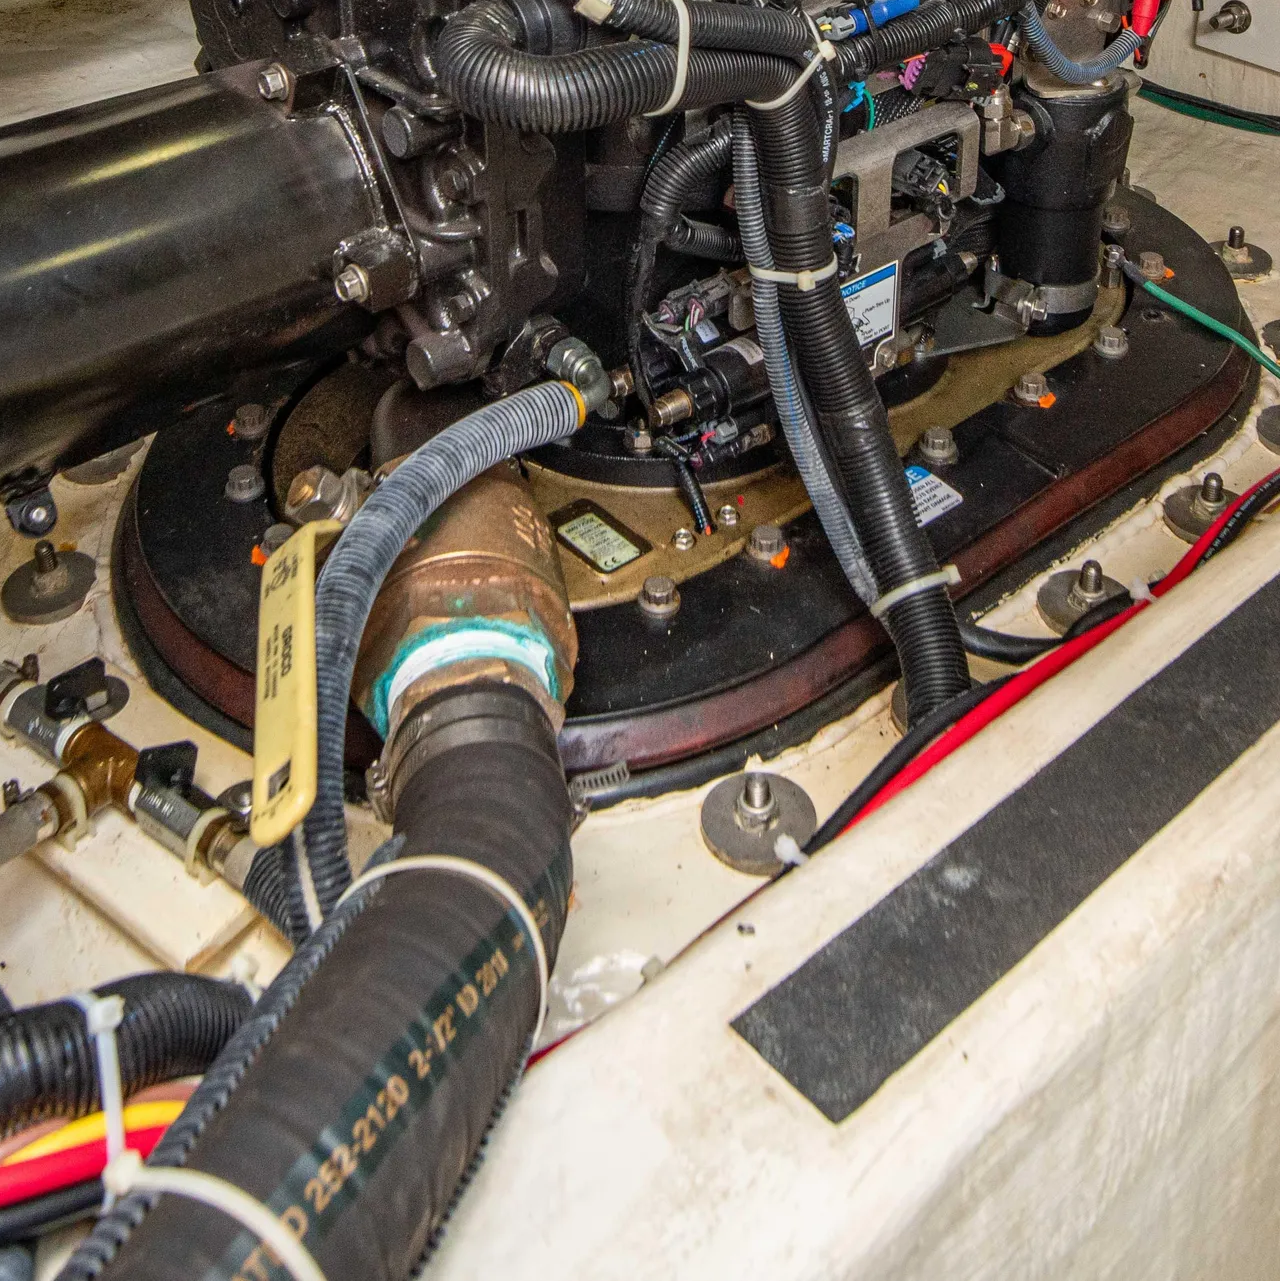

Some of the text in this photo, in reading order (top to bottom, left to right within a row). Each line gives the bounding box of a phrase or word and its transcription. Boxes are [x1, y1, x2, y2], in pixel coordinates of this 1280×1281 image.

[841, 280, 867, 297] NOTICE
[281, 624, 293, 678] GROCO
[303, 1074, 410, 1214] 252-2120
